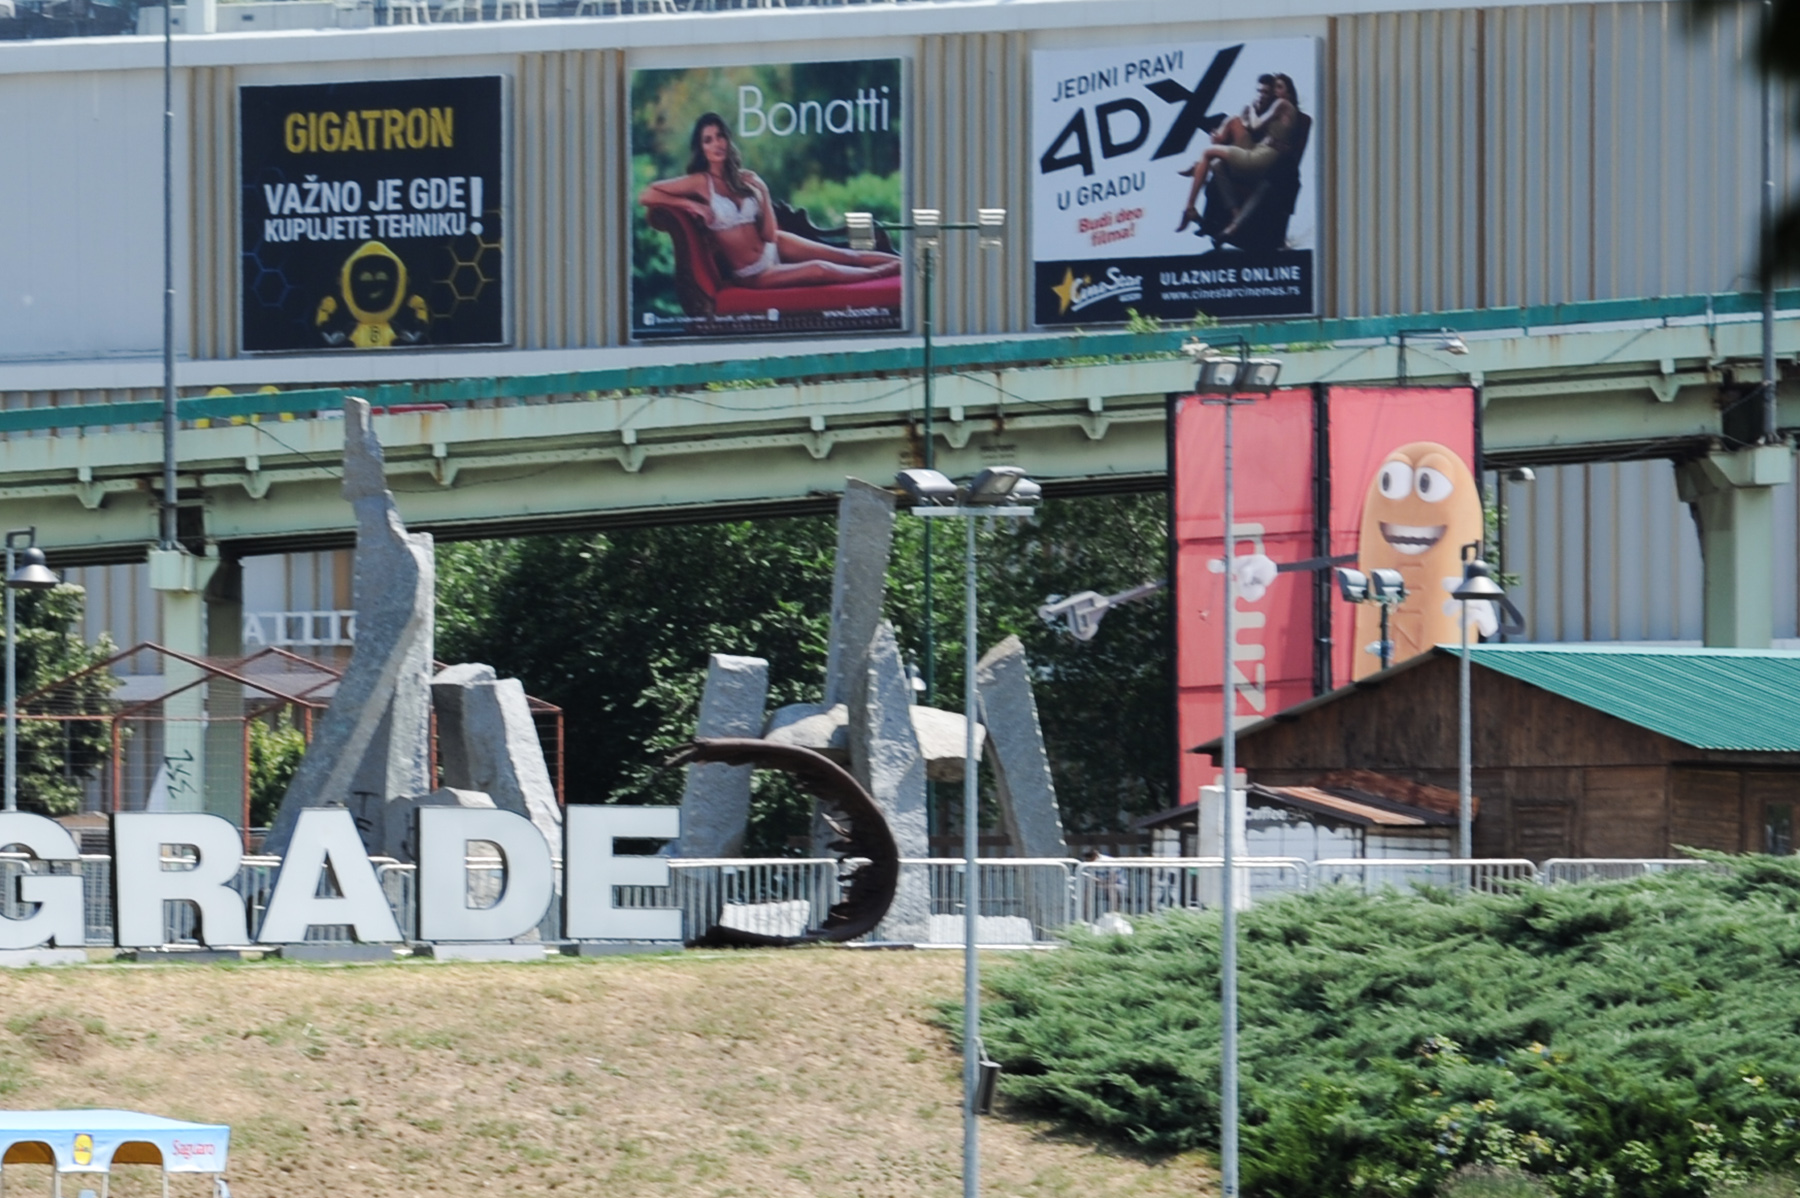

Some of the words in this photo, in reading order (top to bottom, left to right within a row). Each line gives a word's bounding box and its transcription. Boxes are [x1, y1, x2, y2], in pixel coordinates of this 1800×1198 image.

[1052, 67, 1119, 102] JEDINI
[1124, 50, 1184, 84] PRAVI
[284, 107, 454, 153] GIGATRON
[738, 85, 890, 138] Bonatti
[1040, 43, 1246, 177] 4DX
[263, 174, 361, 215] VAŽNO
[368, 179, 403, 211] JE
[1057, 189, 1071, 211] U
[1077, 171, 1146, 207] GRADU
[264, 217, 372, 242] KUPUJETE
[1160, 268, 1237, 286] ULAZNICE
[1241, 265, 1300, 282] ONLINE
